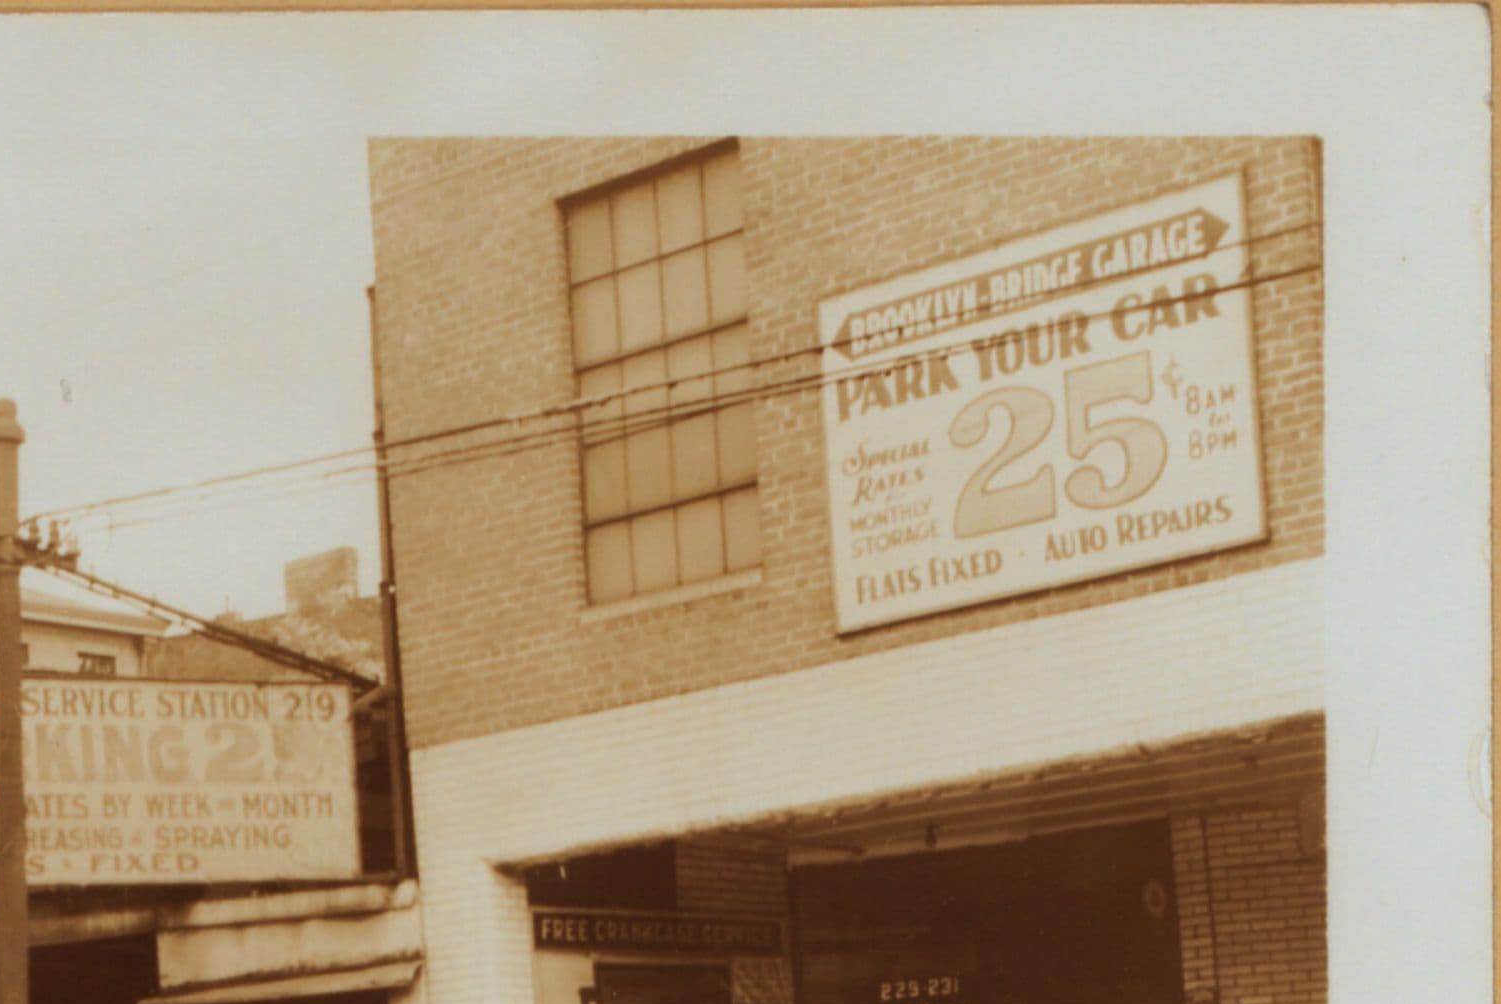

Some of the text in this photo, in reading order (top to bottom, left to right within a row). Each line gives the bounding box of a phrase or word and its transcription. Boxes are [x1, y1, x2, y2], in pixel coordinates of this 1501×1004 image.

[1092, 214, 1205, 279] GARAGE
[836, 272, 1220, 421] PARK YOUR CAR
[851, 498, 933, 533] MONTHLY
[1044, 496, 1233, 564] AUTO REPAIRS
[851, 520, 941, 559] STORAGE
[857, 549, 1003, 605] FLATS FIXED
[22, 686, 145, 719] SERVICE
[156, 688, 270, 720] STATION
[283, 690, 337, 723] 219
[26, 792, 88, 820] ATES
[103, 792, 131, 819] BY
[147, 791, 212, 818] WEEK
[242, 791, 334, 819] MONTH
[26, 826, 123, 852] REASING
[155, 824, 292, 849] SPRAYING
[90, 852, 201, 874] FIXED
[541, 917, 589, 943] FREE
